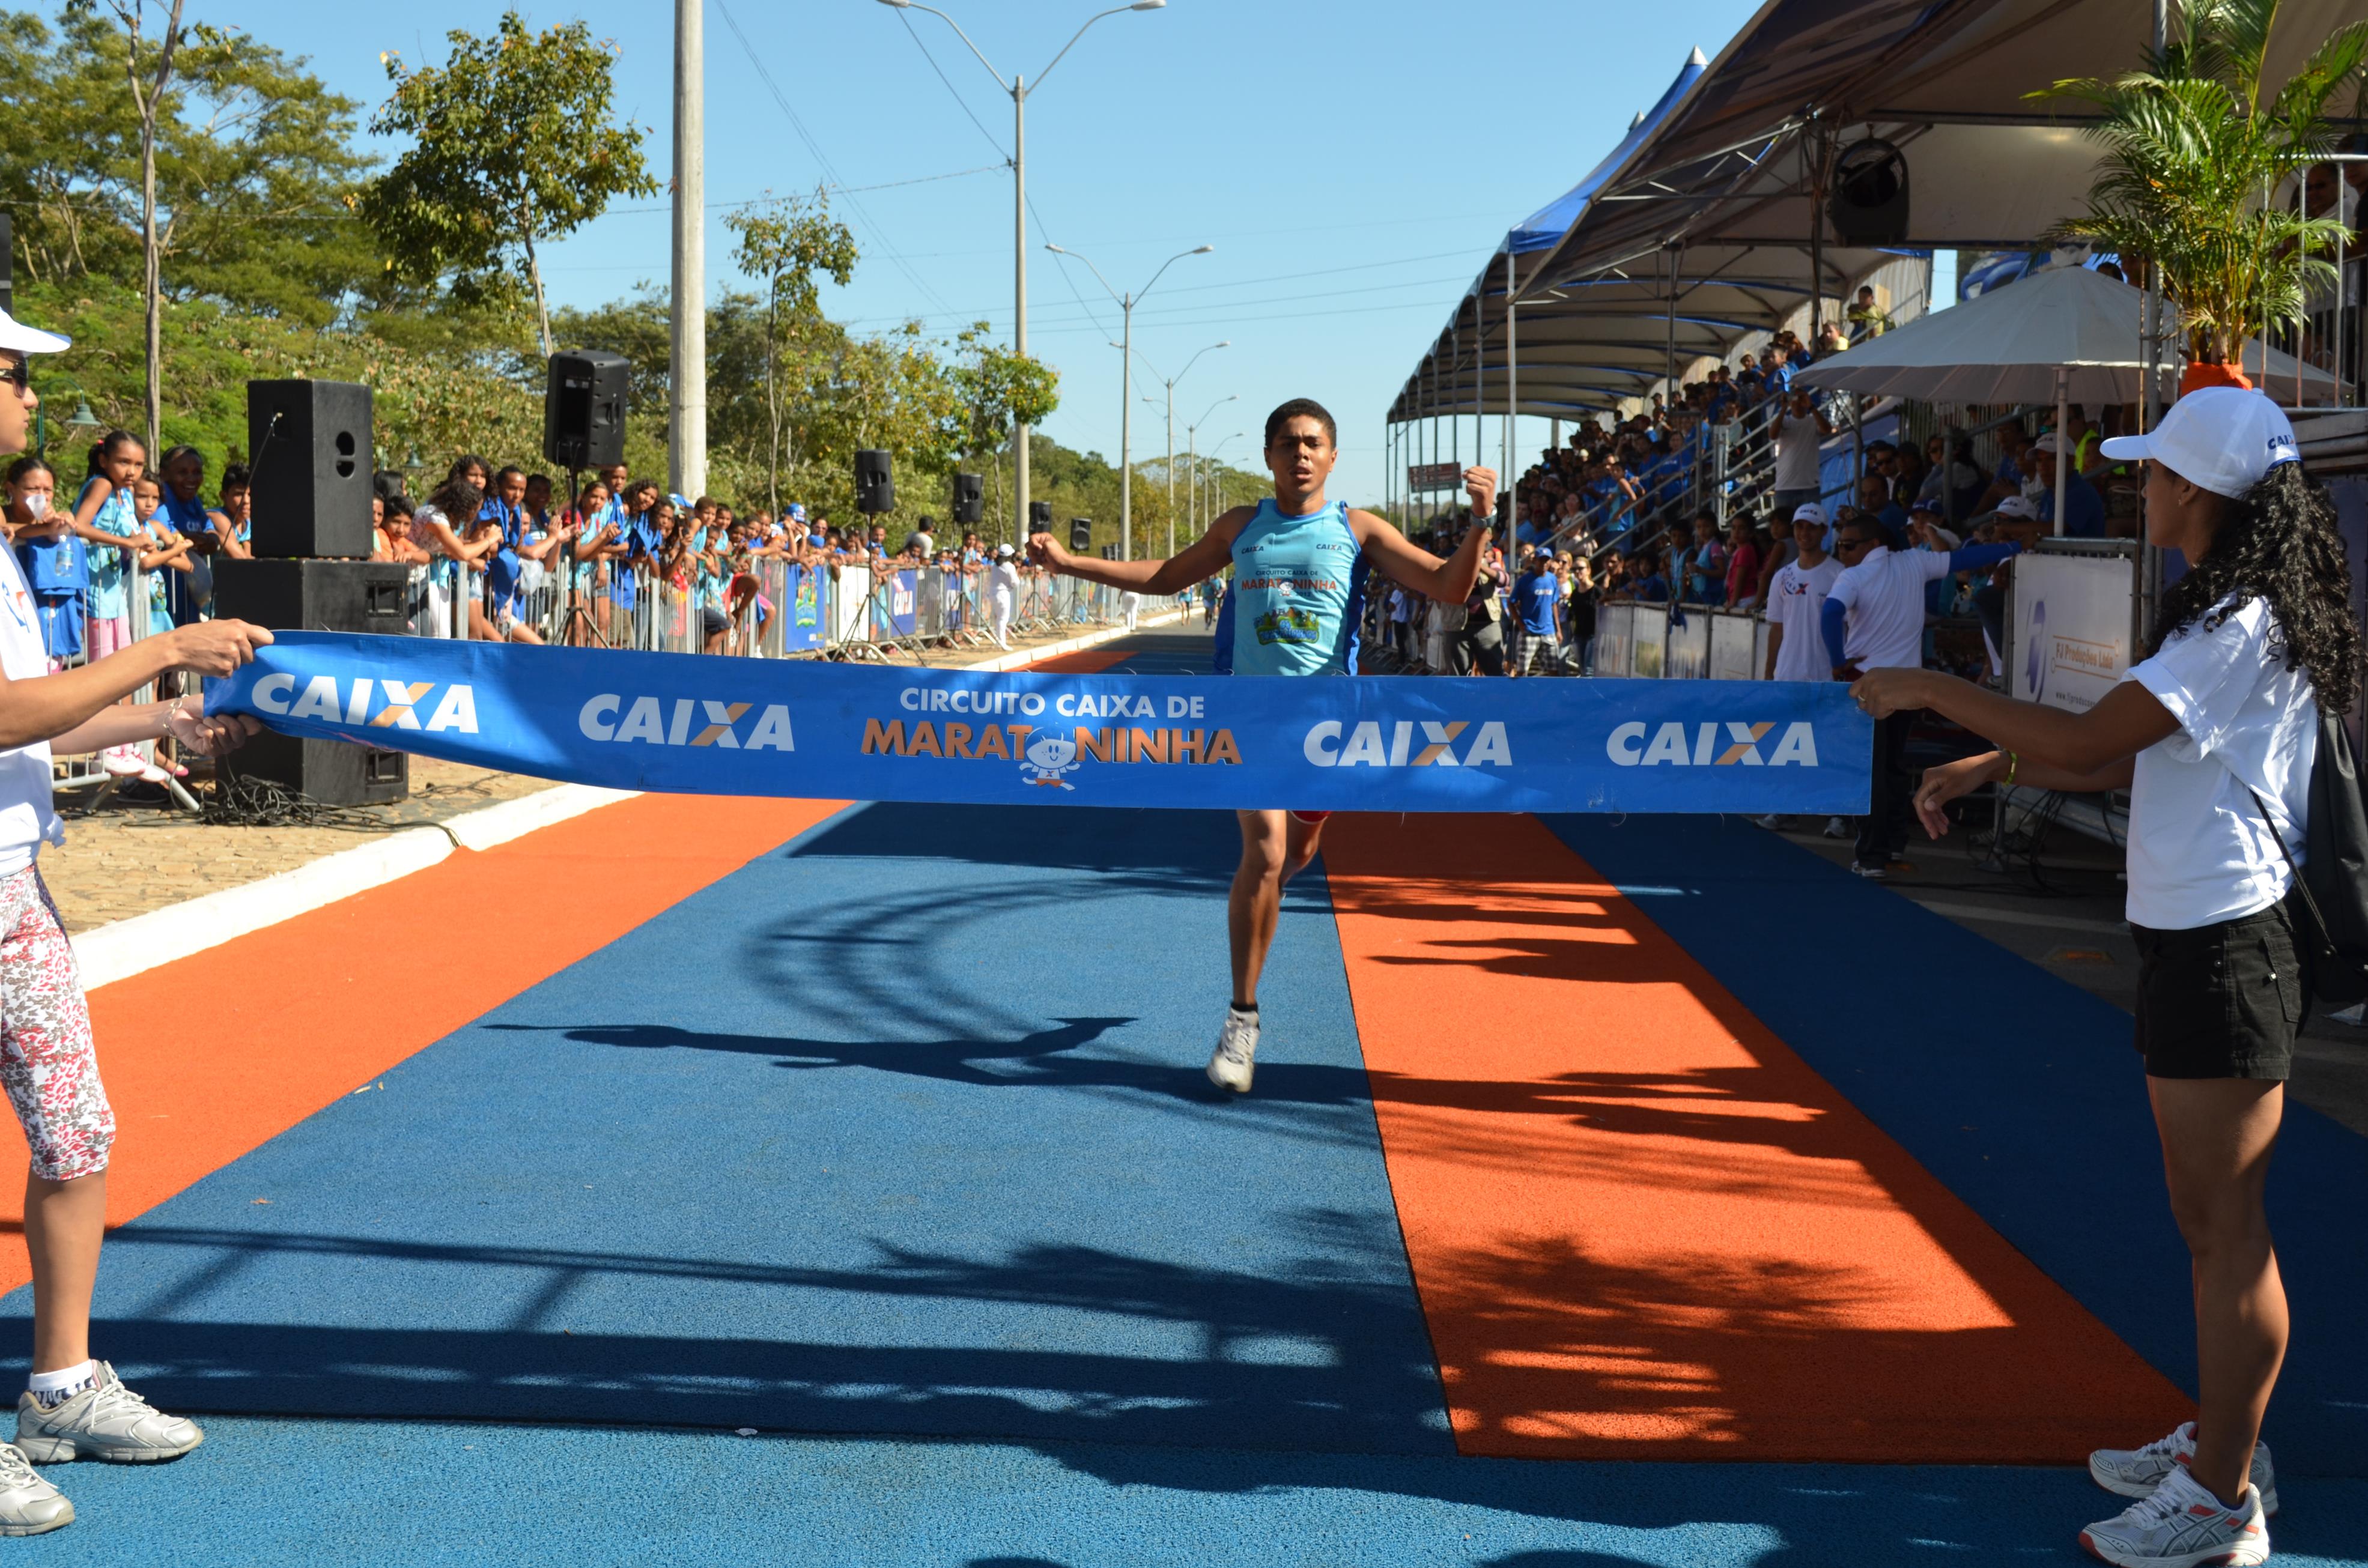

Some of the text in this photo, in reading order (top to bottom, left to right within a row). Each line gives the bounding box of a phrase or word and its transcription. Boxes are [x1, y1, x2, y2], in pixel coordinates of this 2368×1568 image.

[1241, 545, 1264, 554] CAIXA
[2056, 642, 2113, 670] FJ Produções Ltda
[252, 672, 479, 734] CAIXA
[578, 693, 795, 752] CAIXA
[900, 687, 1204, 719] CIRCUITO CAIXA DE
[1304, 720, 1513, 767] CAIXA
[1606, 721, 1818, 766] CAIXA
